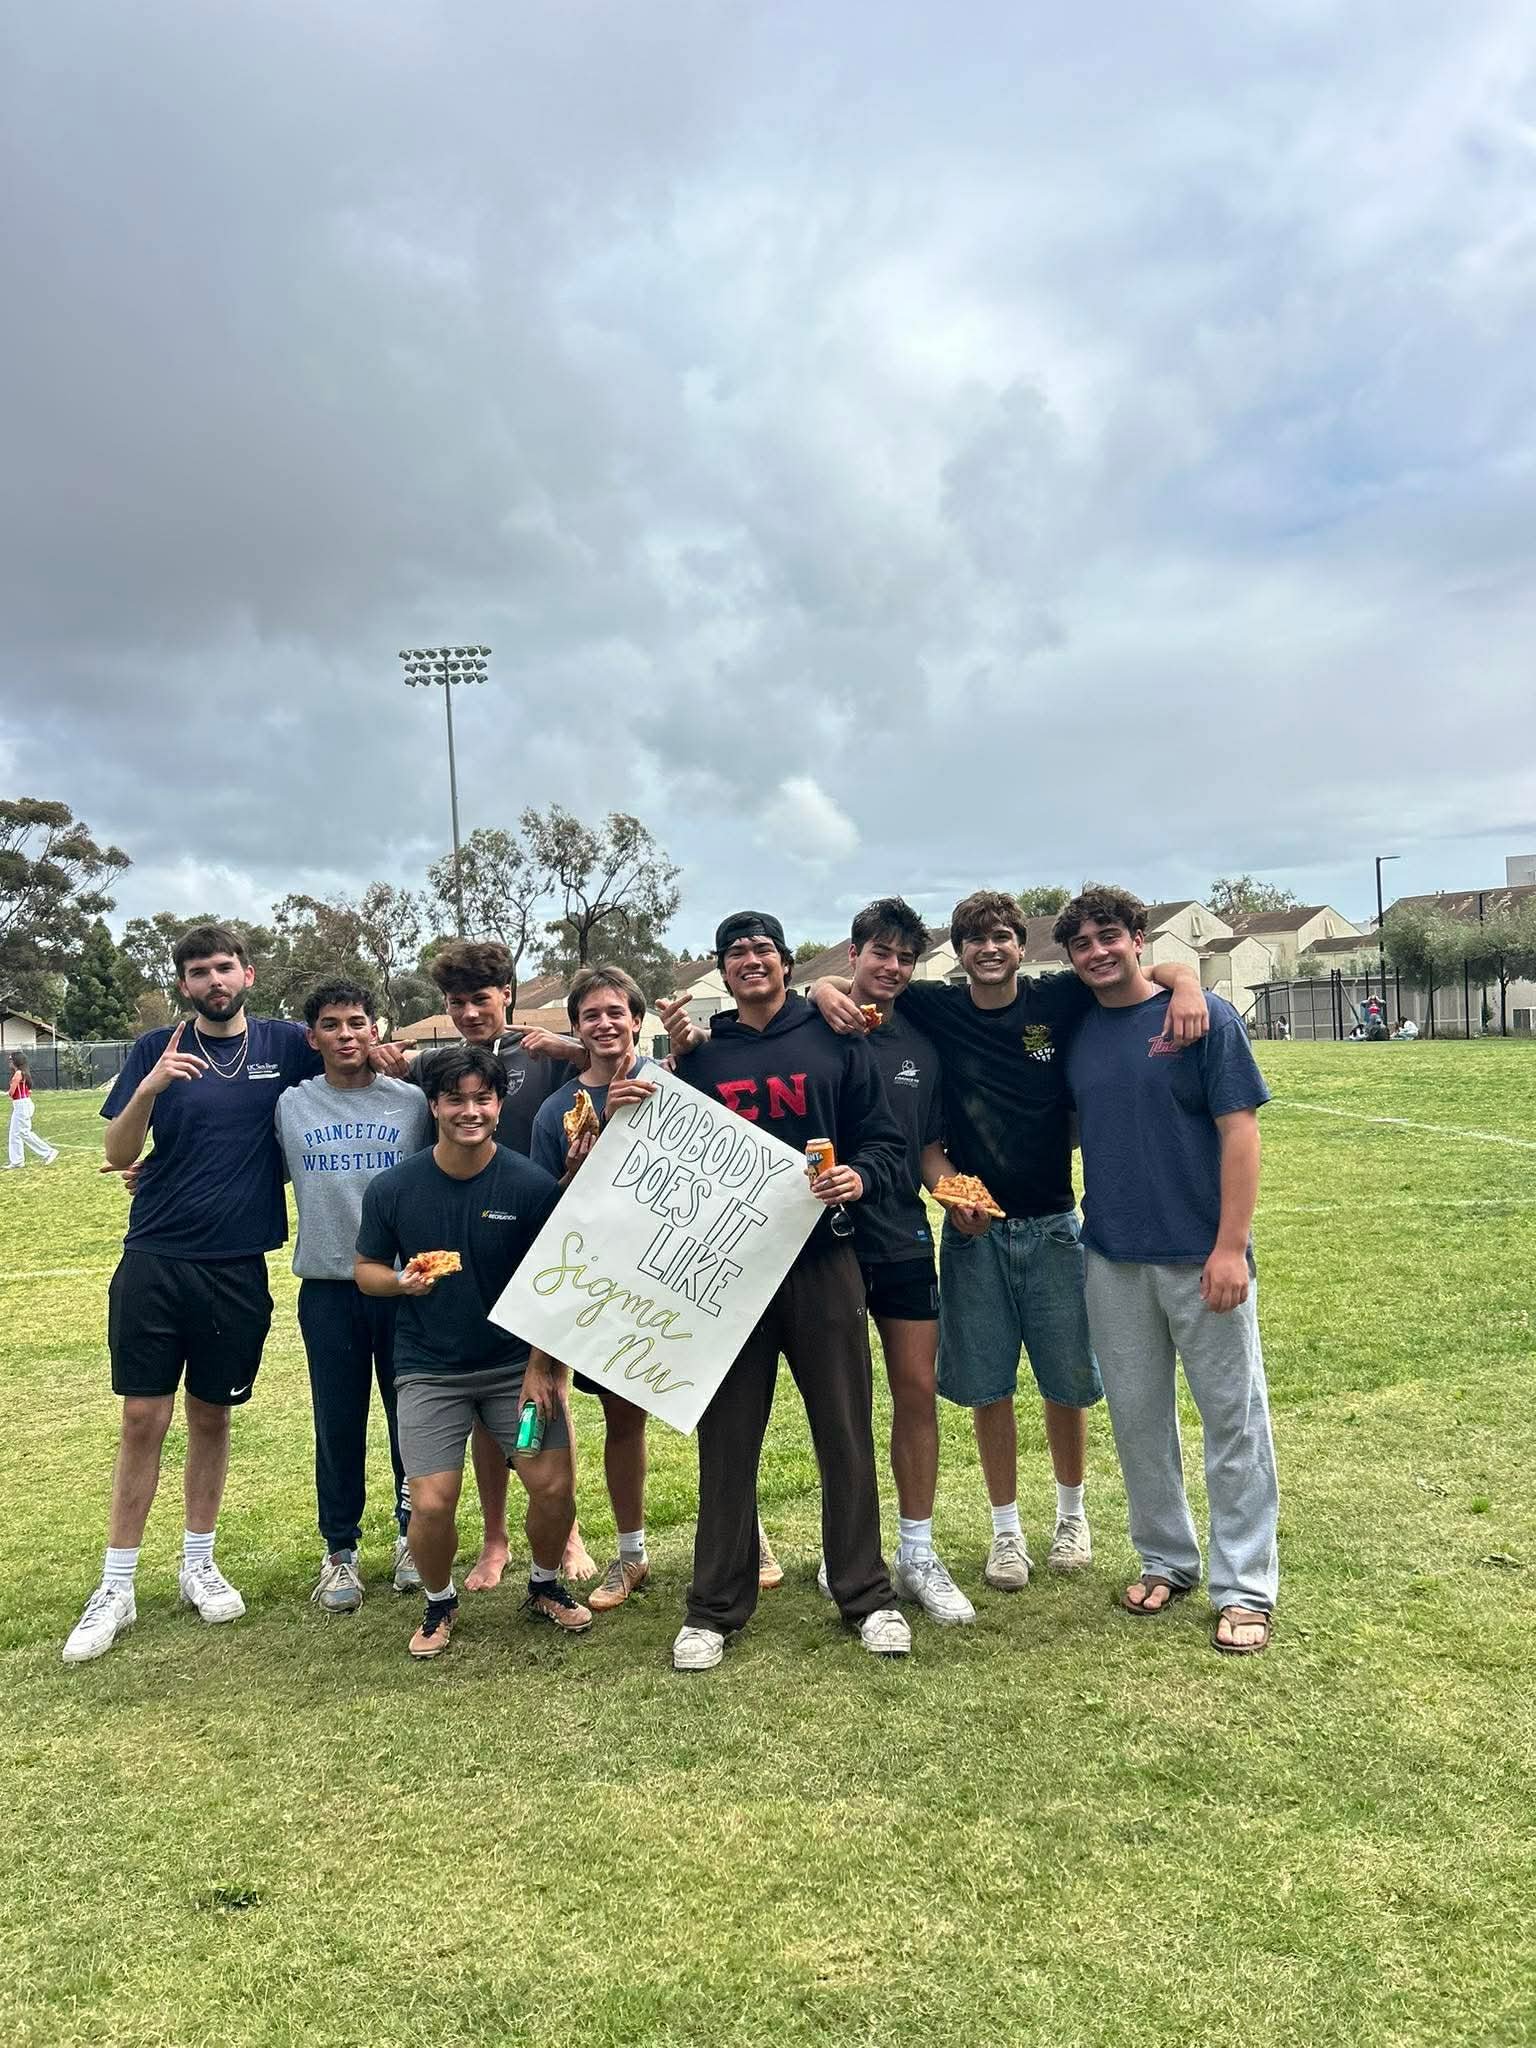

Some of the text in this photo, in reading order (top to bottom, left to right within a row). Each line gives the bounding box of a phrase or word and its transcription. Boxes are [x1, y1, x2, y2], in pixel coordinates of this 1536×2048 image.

[304, 1123, 401, 1149] PRINCETON
[628, 1080, 794, 1204] NOBODY
[612, 1139, 769, 1255] DOES IT
[532, 1231, 694, 1340] Sigma
[637, 1222, 744, 1318] LIKE
